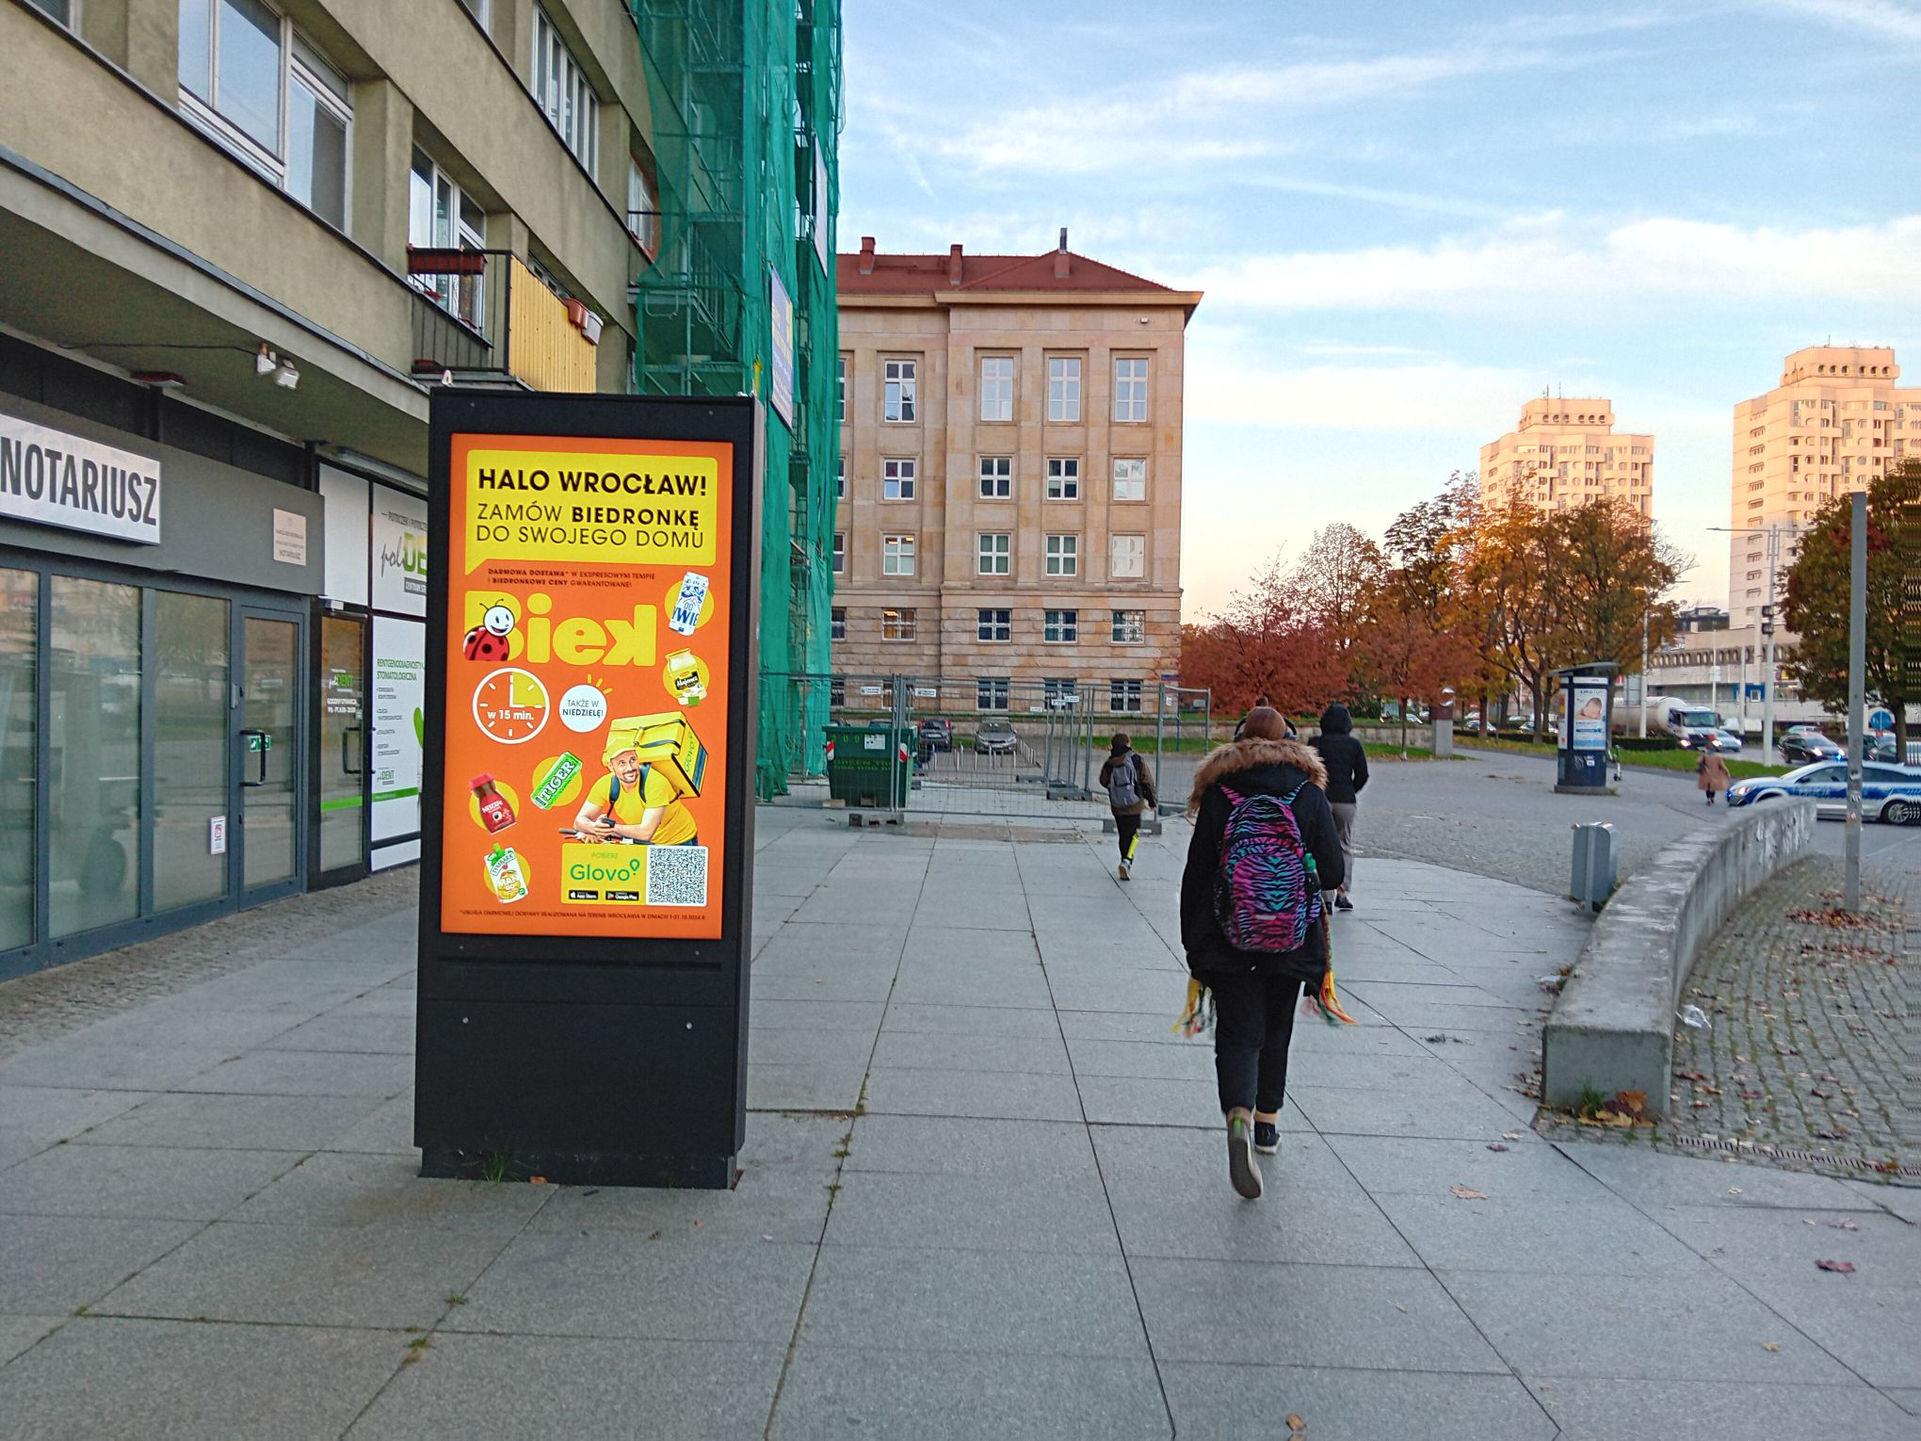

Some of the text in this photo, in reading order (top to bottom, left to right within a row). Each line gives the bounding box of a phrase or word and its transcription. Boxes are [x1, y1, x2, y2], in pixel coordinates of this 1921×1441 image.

[1, 436, 158, 526] NOTARIUSZ
[478, 468, 707, 497] HALO WROCŁAW!
[477, 500, 700, 530] ZAMÓW BIEDRONKĘ
[476, 524, 704, 548] DO SWOJEGO DOMU
[487, 568, 527, 576] DARMOWA
[631, 572, 655, 581] TEMPIE
[492, 577, 546, 585] BIEDRONKOWE
[567, 698, 599, 708] TAKŻE W
[487, 710, 534, 720] w 15 min.
[540, 760, 575, 801] TIGER
[570, 863, 630, 881] Glovo
